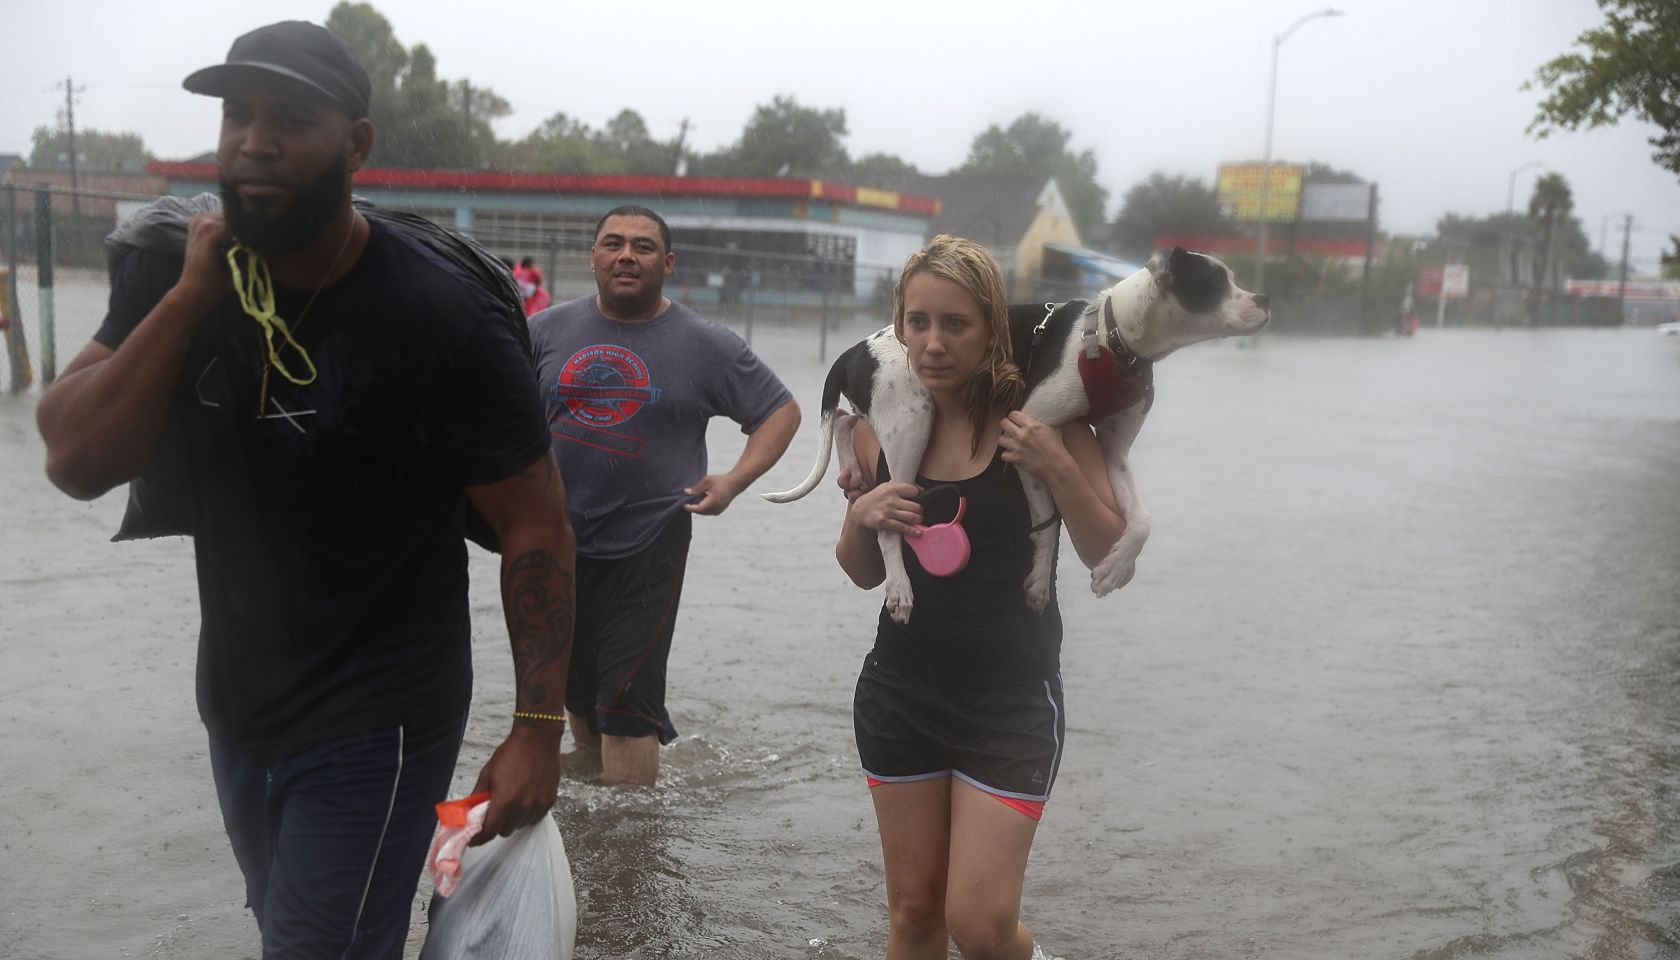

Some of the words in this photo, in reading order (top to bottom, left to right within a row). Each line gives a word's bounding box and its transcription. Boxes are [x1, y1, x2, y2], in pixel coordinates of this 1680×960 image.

[574, 350, 604, 364] MADISON
[606, 350, 624, 359] HIGH
[626, 356, 643, 379] SCHOOL
